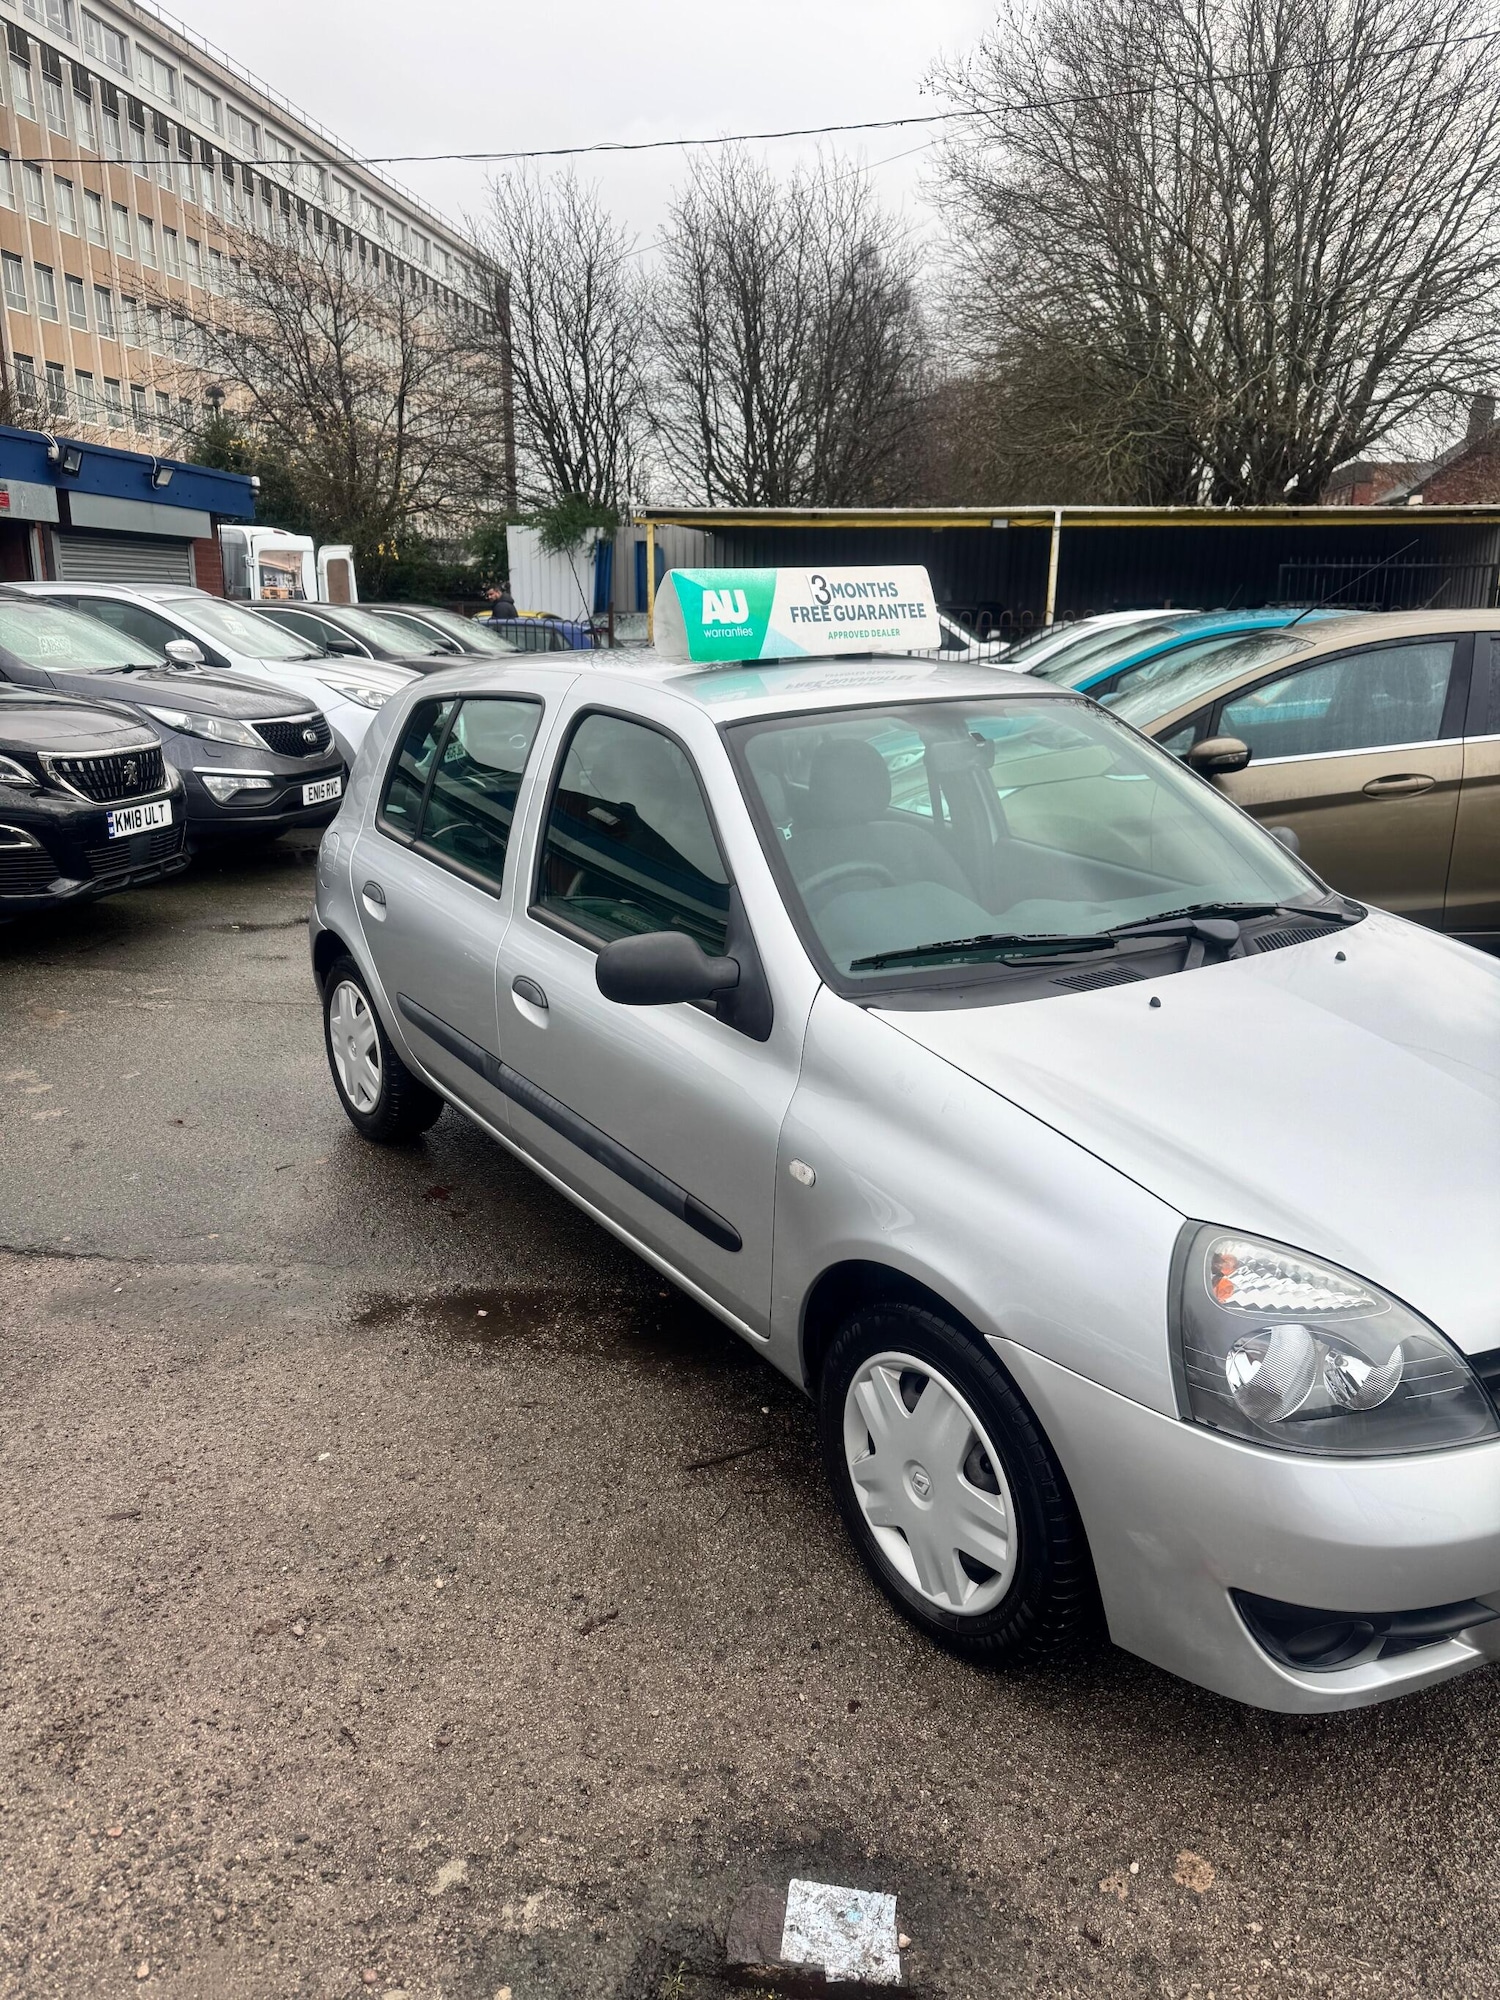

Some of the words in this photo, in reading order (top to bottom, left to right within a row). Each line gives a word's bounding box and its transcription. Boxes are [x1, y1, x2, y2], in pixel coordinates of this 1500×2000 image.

[811, 574, 832, 605] 3
[830, 582, 899, 599] MONTHS
[701, 589, 750, 625] AU
[790, 605, 832, 623] FREE
[833, 603, 927, 622] GUARANTEE
[703, 626, 754, 638] warranties
[828, 629, 870, 640] APPROVED
[871, 628, 901, 638] DEALER
[308, 784, 325, 801] EN15
[115, 809, 142, 833] KM18
[144, 804, 164, 826] ULT
